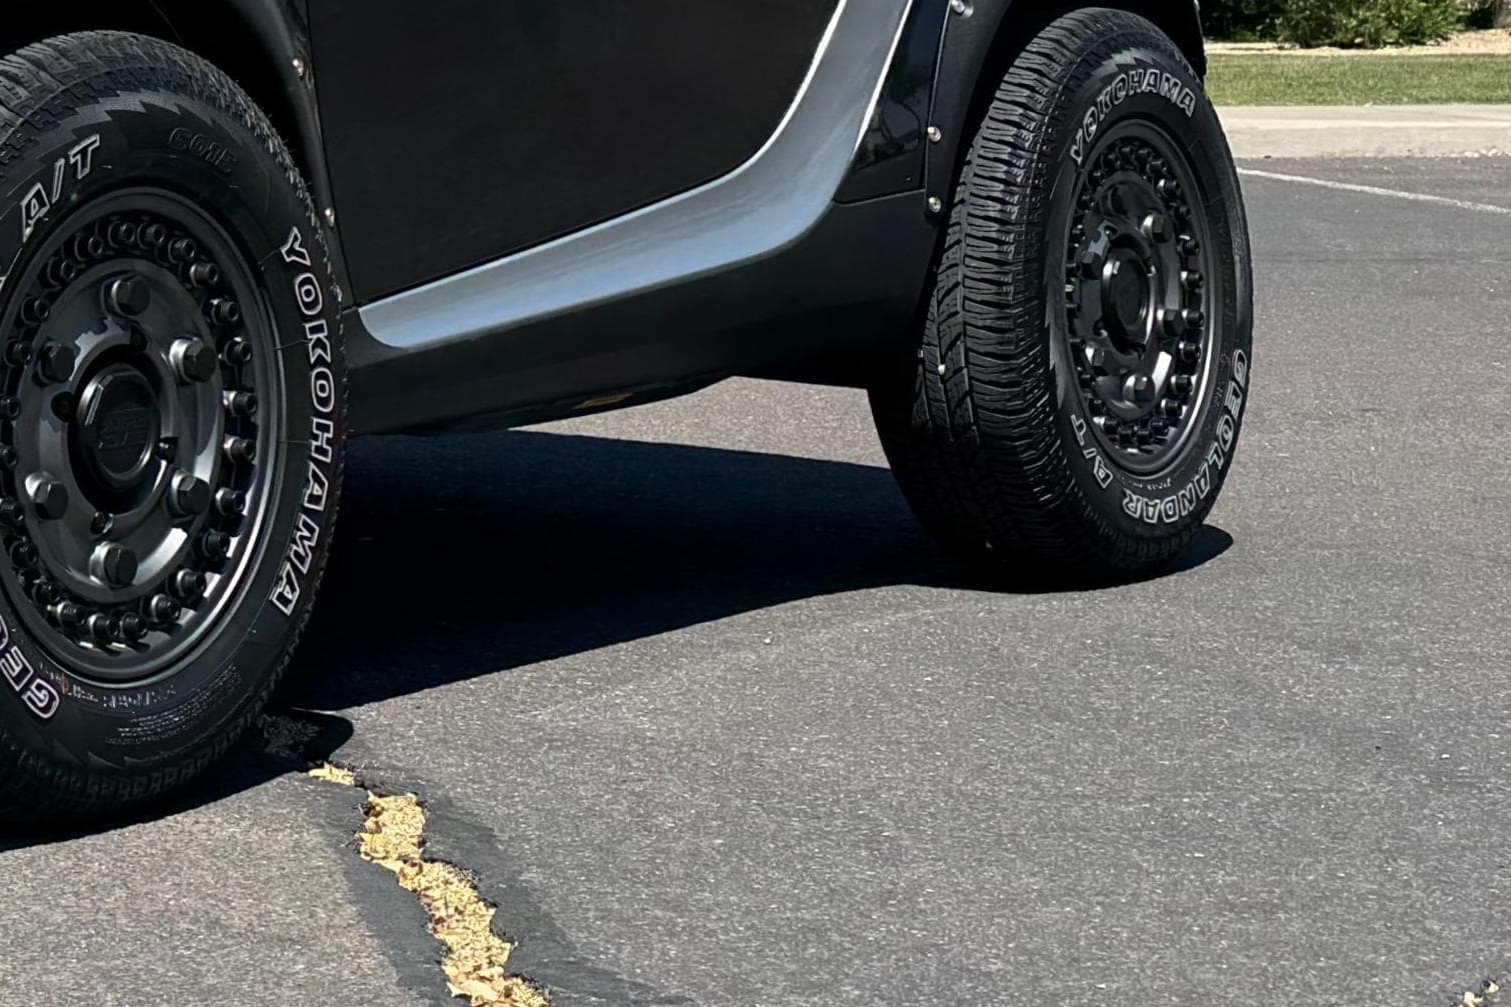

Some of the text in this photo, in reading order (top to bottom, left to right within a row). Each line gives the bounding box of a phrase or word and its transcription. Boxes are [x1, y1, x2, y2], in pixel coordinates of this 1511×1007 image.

[19, 133, 101, 243] A/T
[1070, 69, 1196, 166] YOKOHAMA
[269, 225, 336, 616] YOKOHAMA
[1070, 348, 1248, 524] GEOLANDAR A/T
